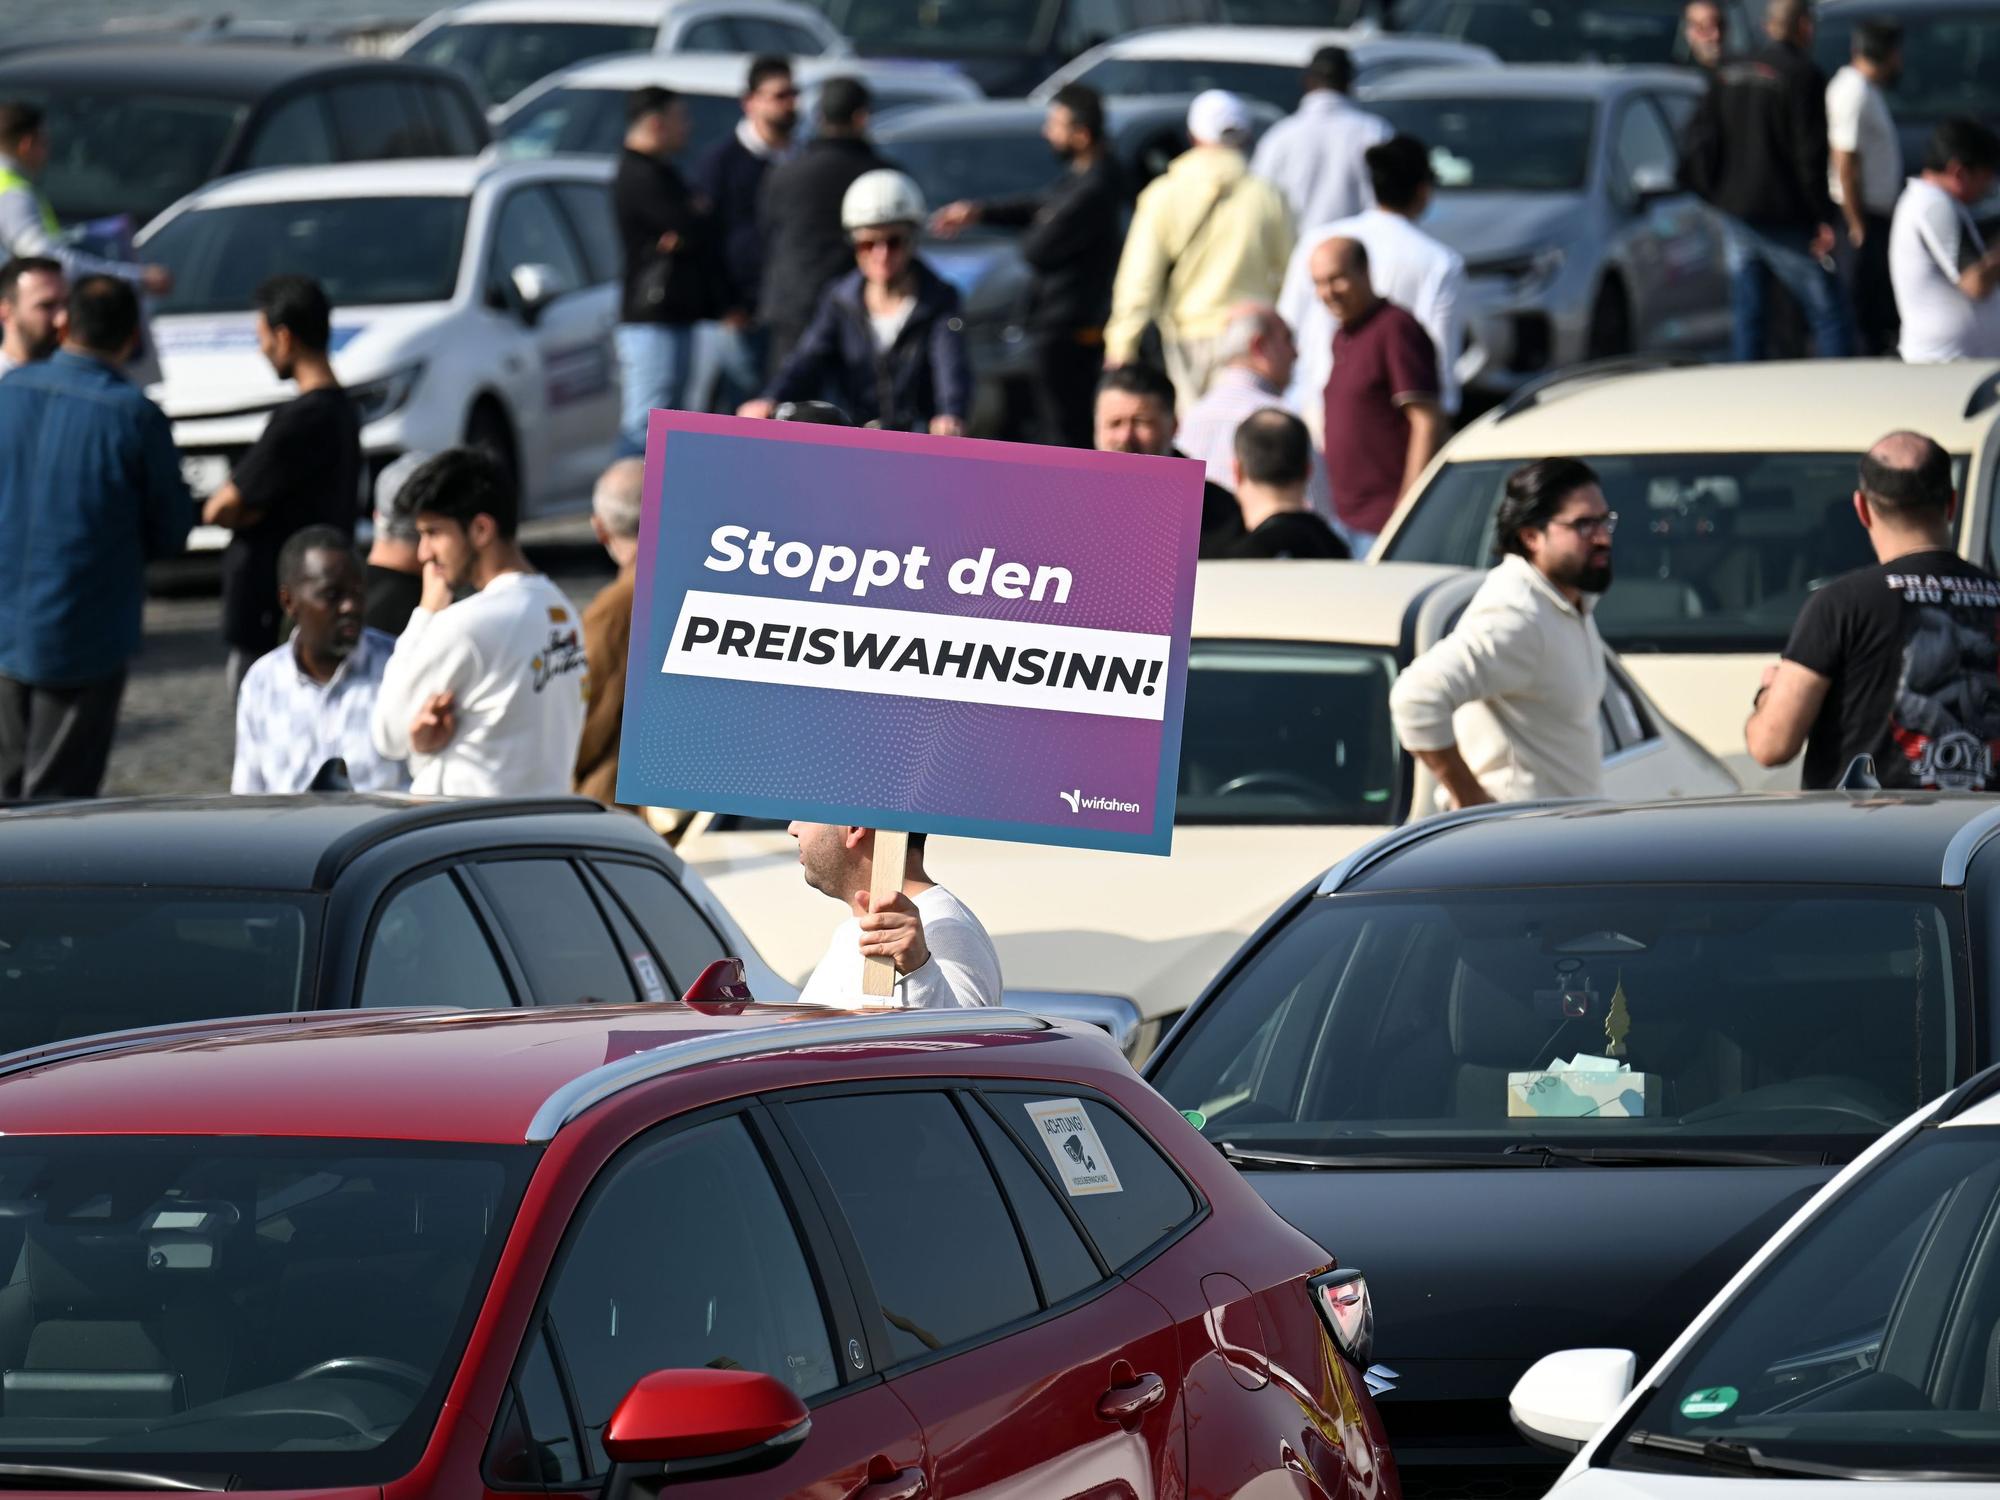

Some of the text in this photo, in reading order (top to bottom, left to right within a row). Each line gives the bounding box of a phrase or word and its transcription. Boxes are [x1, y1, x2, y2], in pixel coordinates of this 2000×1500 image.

[704, 525, 1073, 604] Stoppt den
[681, 616, 1164, 697] PREISWAHNSINN!
[1081, 796, 1140, 813] wirfahren
[1043, 1115, 1086, 1135] ACHTUNG!
